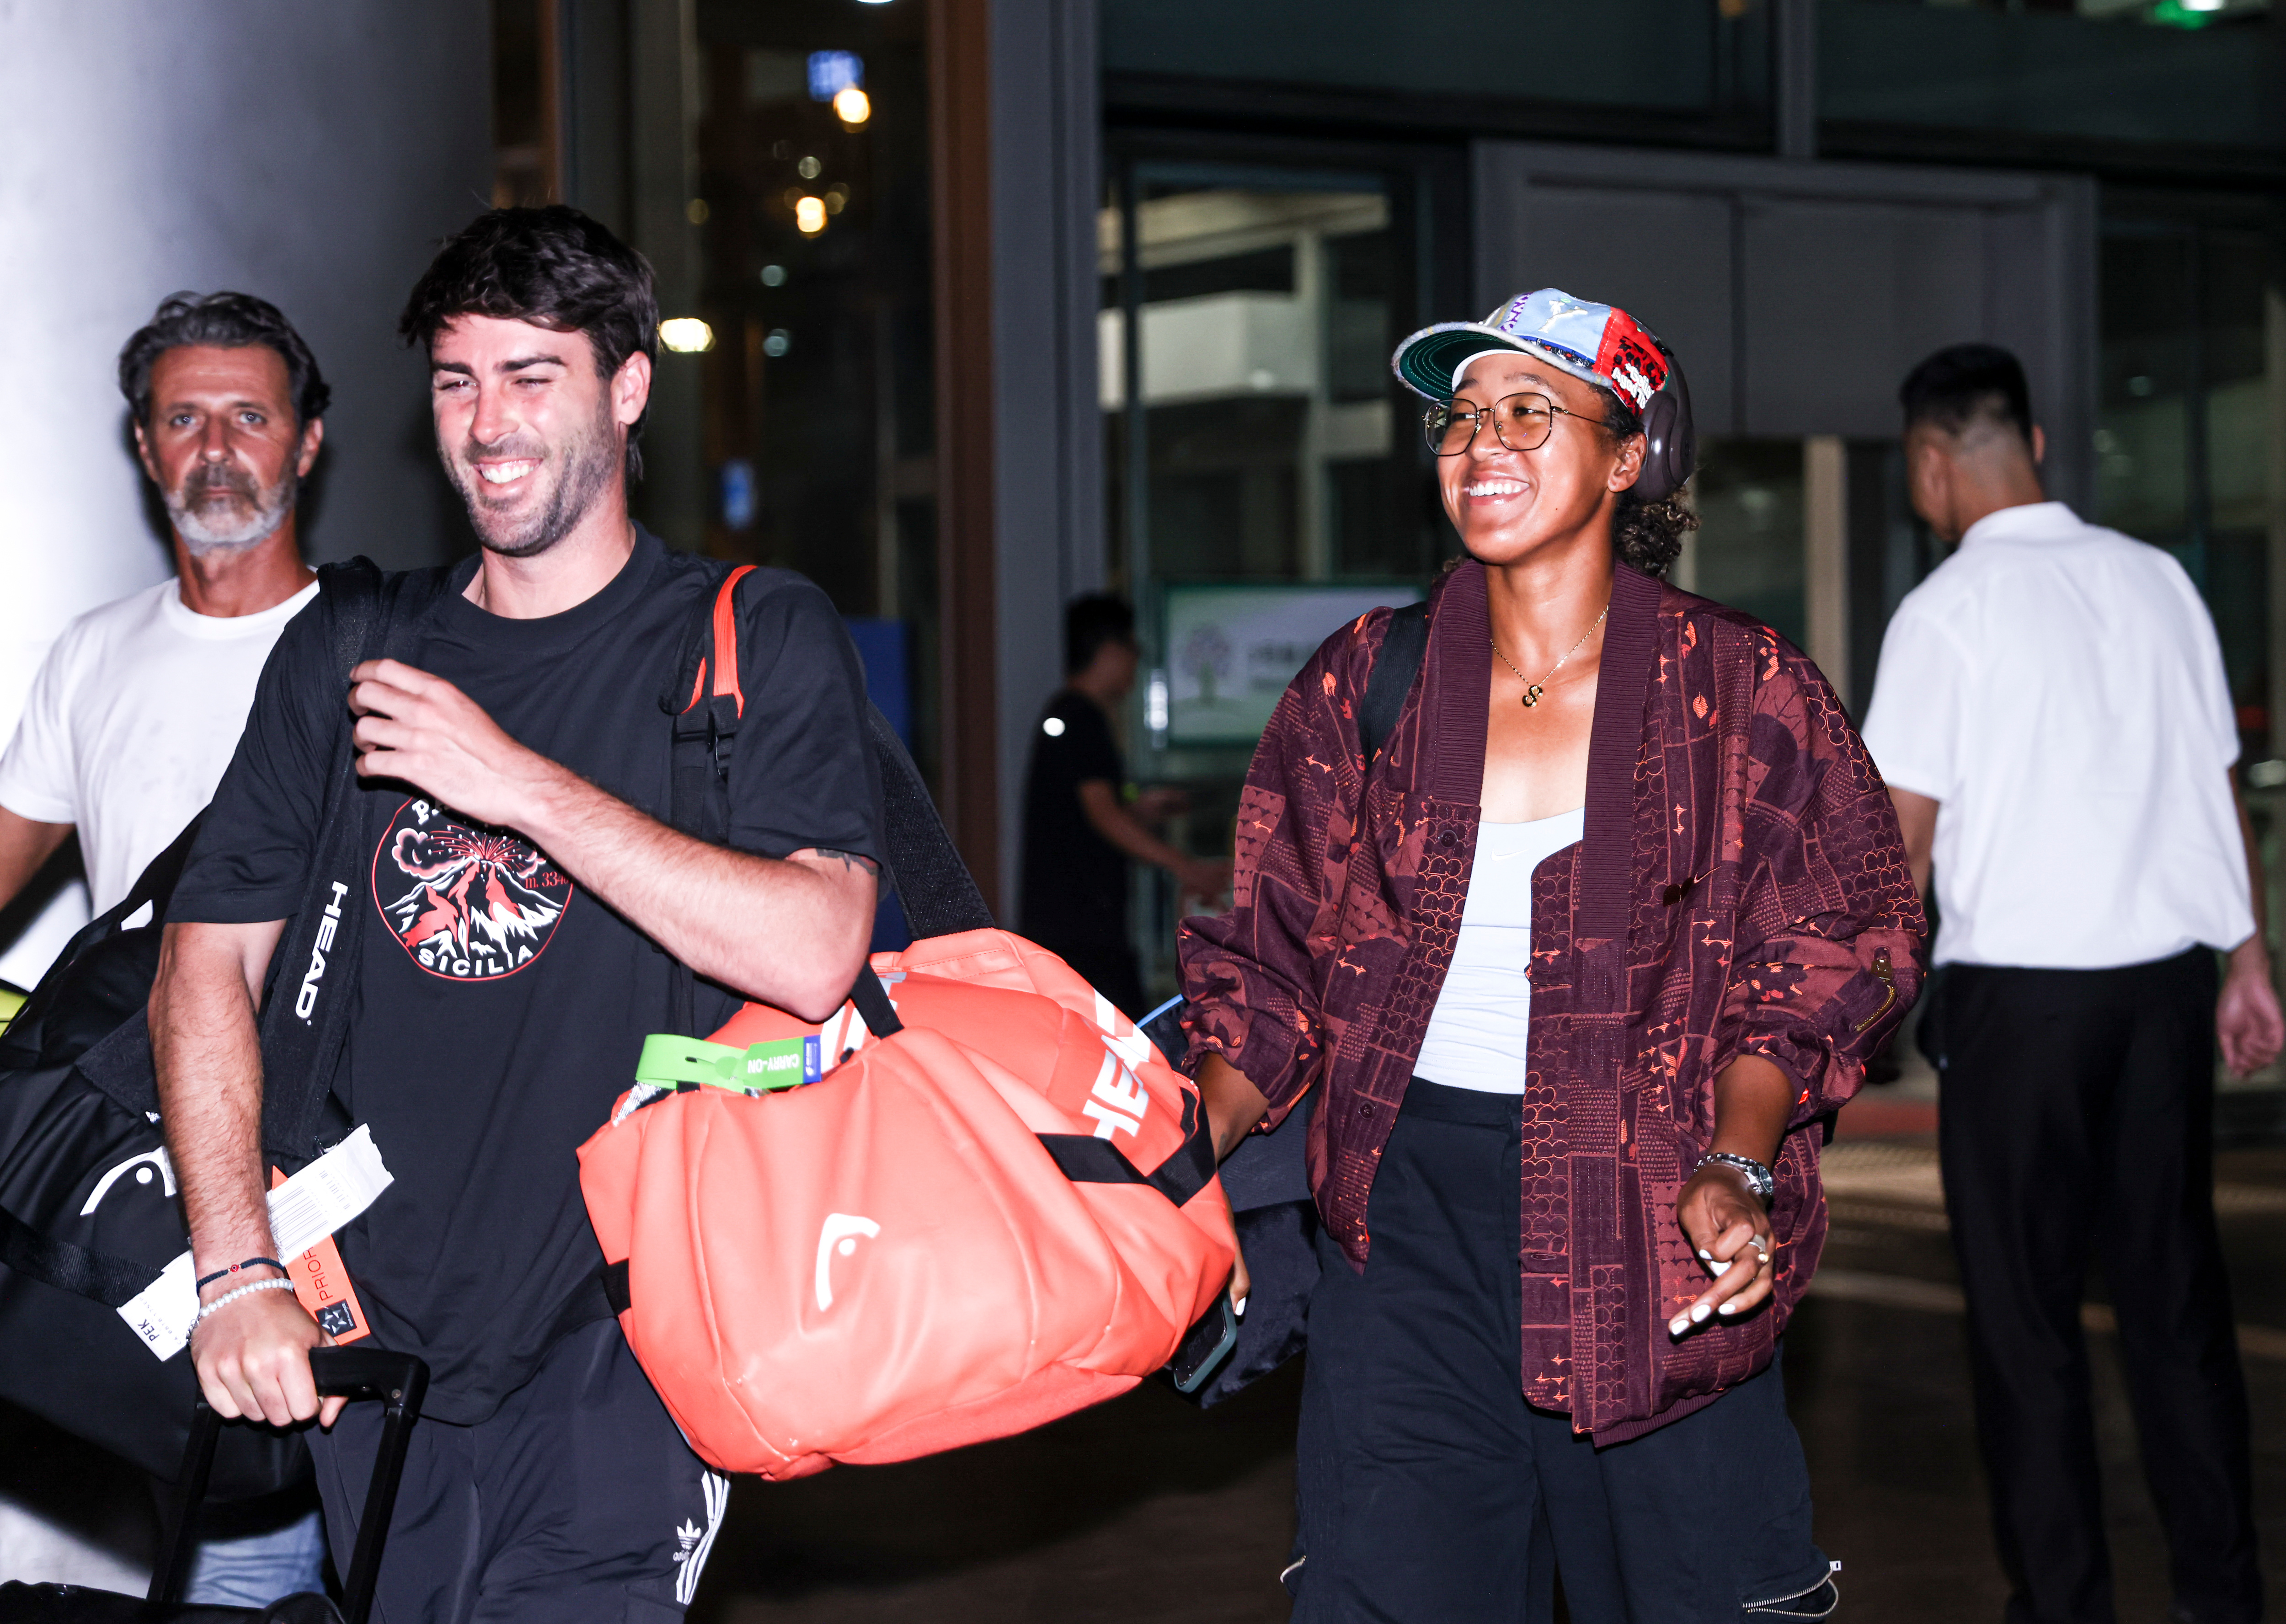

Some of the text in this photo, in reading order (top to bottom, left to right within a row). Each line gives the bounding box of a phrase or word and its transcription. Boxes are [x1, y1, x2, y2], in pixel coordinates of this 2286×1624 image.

[295, 881, 348, 1019] HEAD
[418, 945, 534, 976] SICILIA
[747, 1053, 800, 1074] CARRY-ON
[138, 1319, 160, 1341] PEK
